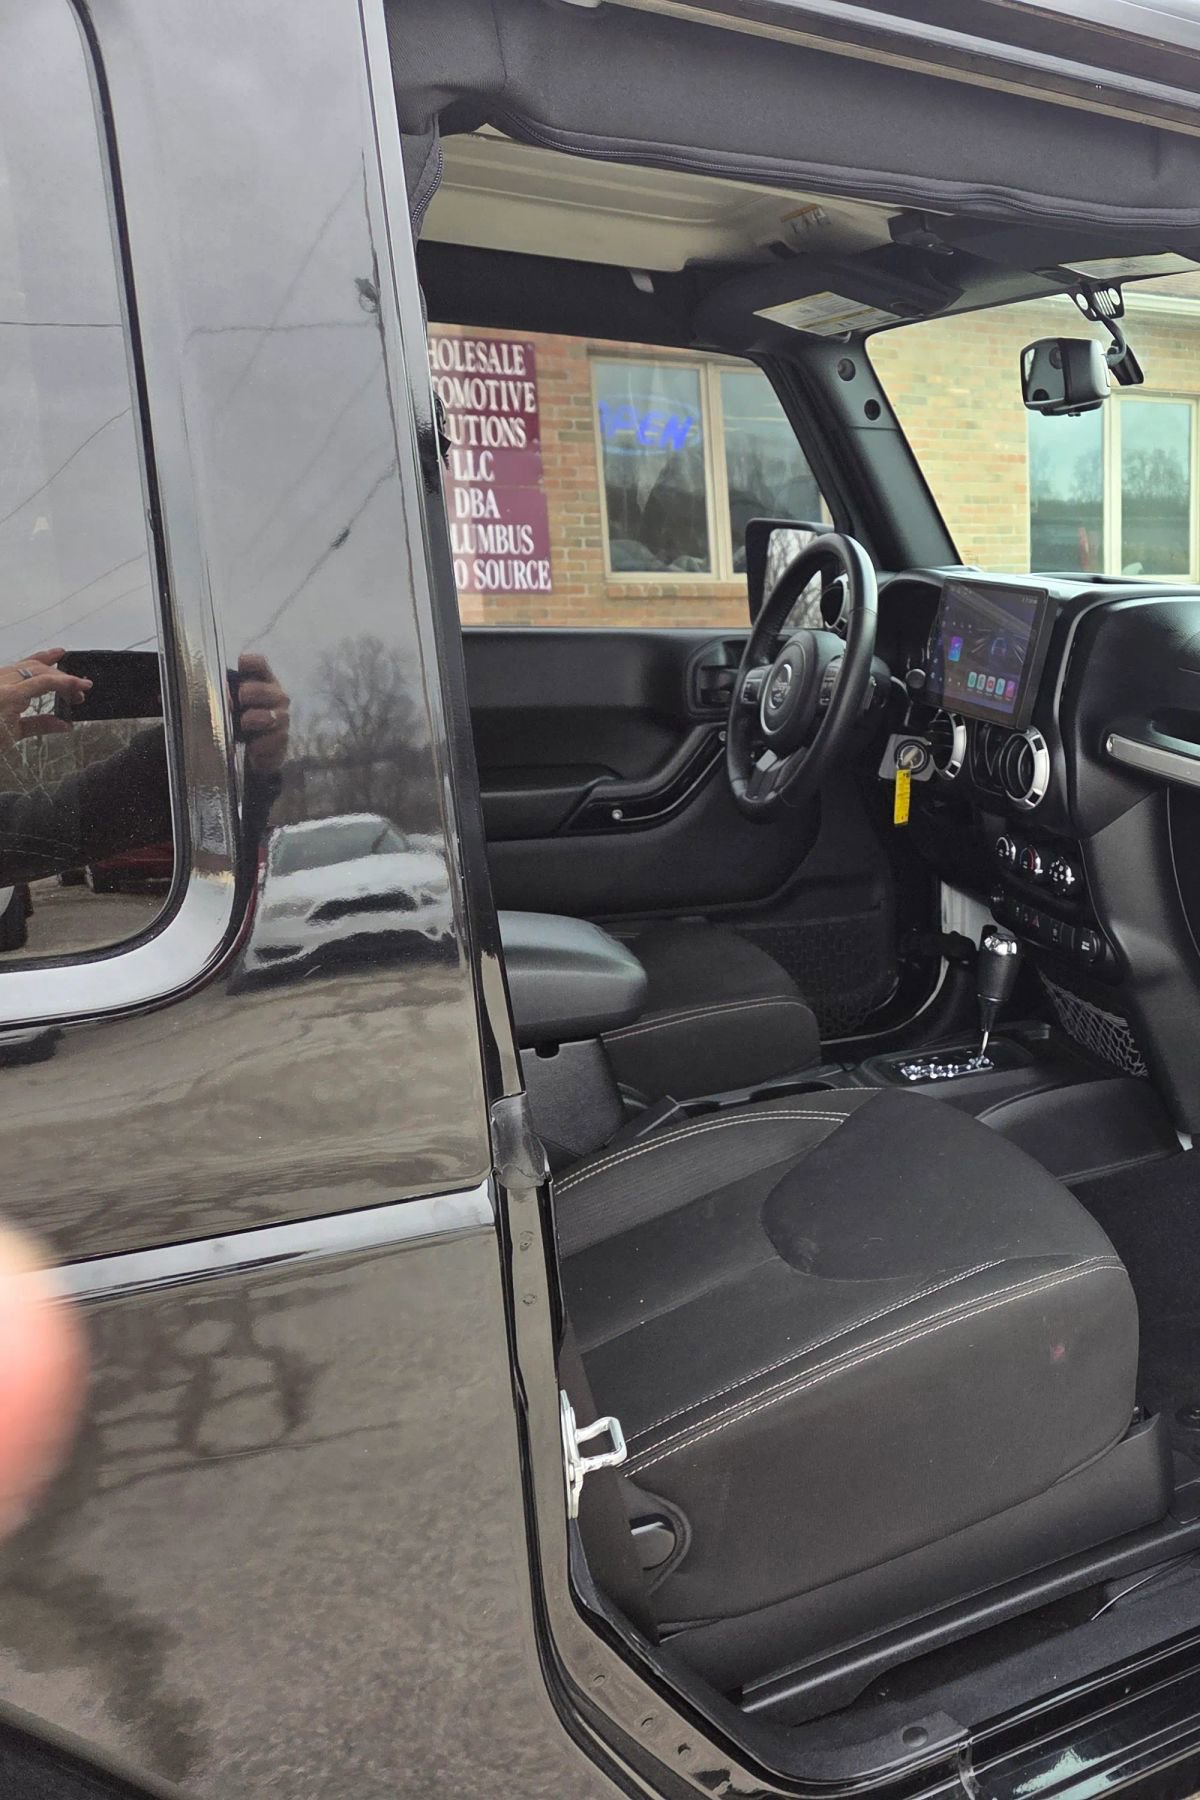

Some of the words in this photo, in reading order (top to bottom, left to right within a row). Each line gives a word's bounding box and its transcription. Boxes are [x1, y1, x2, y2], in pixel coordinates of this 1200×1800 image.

[428, 337, 526, 377] HOLESALE
[431, 375, 537, 414] OMOTIVE
[447, 413, 527, 449] UTIONS
[452, 449, 495, 482] LLC
[454, 487, 502, 519] DBA
[450, 522, 535, 555] LUMBUS
[473, 558, 552, 591] SOURCE
